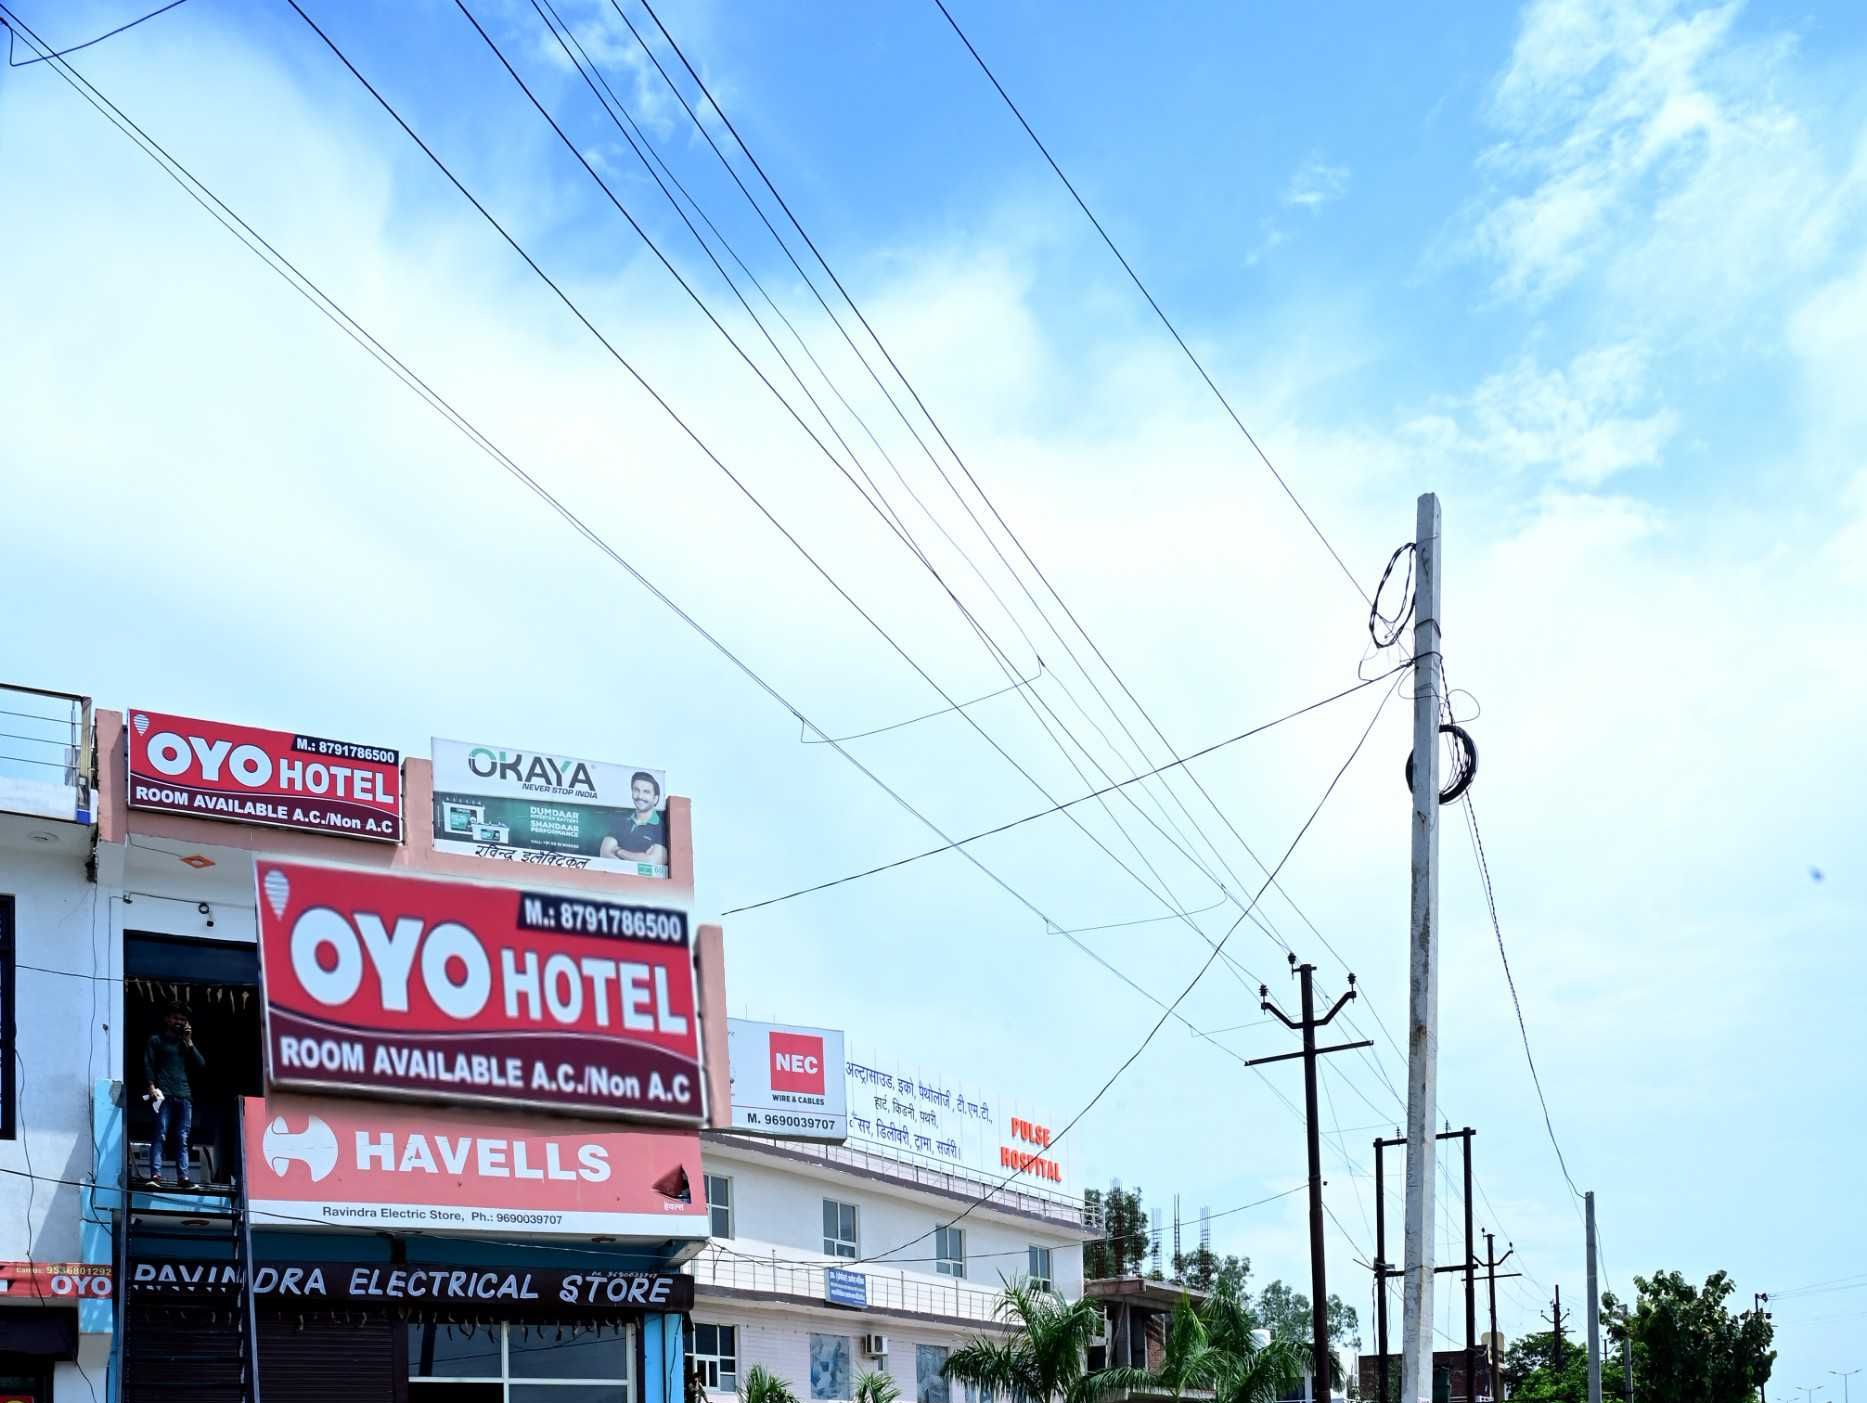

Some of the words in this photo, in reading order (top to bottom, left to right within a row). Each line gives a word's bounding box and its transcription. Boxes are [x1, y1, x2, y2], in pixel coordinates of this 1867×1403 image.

[147, 732, 273, 788] OYO
[279, 758, 395, 805] HOTEL
[318, 740, 395, 764] 8791786500
[467, 747, 597, 792] OKAYA
[521, 783, 551, 793] NEVER
[551, 786, 574, 796] STOP
[574, 789, 599, 799] INDIA
[135, 785, 189, 806] ROOM
[193, 794, 289, 820] AVAILABLE
[292, 809, 362, 830] A.C./Non
[365, 818, 394, 834] A.C
[560, 907, 683, 943] 8791786500
[289, 906, 492, 1021] OYO
[501, 947, 688, 1036] HOTEL
[279, 1035, 366, 1074] ROOM
[373, 1046, 524, 1089] AVAILABLE
[531, 1061, 641, 1100] A.C./Non
[648, 1072, 691, 1104] A.C
[775, 1052, 819, 1074] NEC
[772, 1094, 790, 1103] WIRE
[797, 1095, 825, 1106] CABLES
[747, 1112, 761, 1125] M.
[764, 1113, 836, 1130] 9690039707
[1010, 1116, 1051, 1149] PULSE
[355, 1131, 612, 1183] HAVELLS
[1000, 1145, 1063, 1184] HOSPITAL
[322, 1206, 378, 1218] Ravindra
[380, 1207, 427, 1220] Electric
[429, 1209, 466, 1222] Store,
[471, 1211, 494, 1223] Ph.:
[496, 1212, 563, 1225] 9690039707
[51, 1275, 113, 1296] OYO
[349, 1267, 539, 1300] ELECTRICAL
[559, 1273, 674, 1304] STORE
